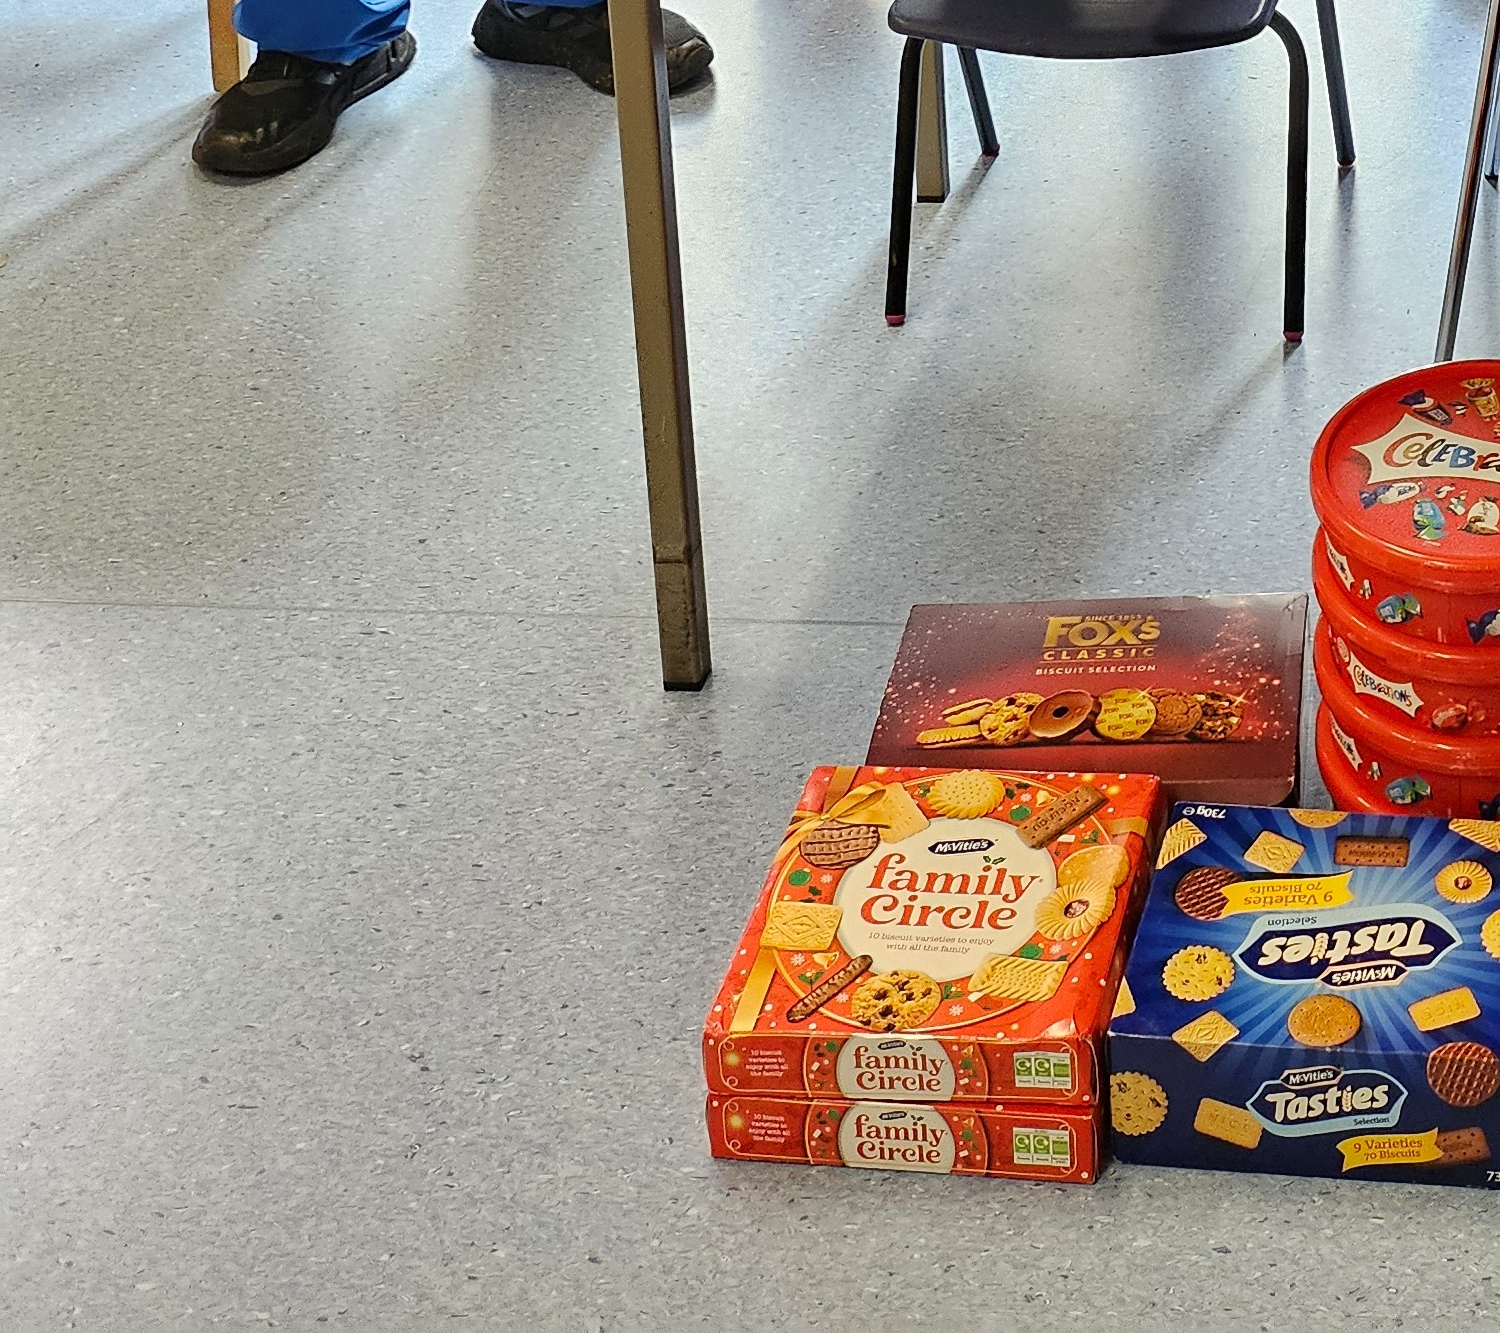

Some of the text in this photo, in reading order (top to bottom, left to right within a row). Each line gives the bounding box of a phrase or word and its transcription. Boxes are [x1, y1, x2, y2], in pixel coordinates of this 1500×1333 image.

[1043, 648, 1155, 661] CLASSIC
[1036, 664, 1156, 675] BISCUIT SELECTION
[1196, 806, 1227, 819] 730g
[866, 853, 1040, 903] family
[1249, 883, 1323, 895] 70 Biscuits
[1244, 891, 1333, 906] 9 Varieties
[860, 894, 1018, 930] Circle
[1267, 916, 1317, 926] Selection
[881, 933, 913, 941] biscuit
[915, 935, 956, 943] varieties
[1258, 919, 1435, 966] Tasties
[909, 943, 922, 951] all
[940, 945, 971, 954] family
[854, 1045, 945, 1077] family
[856, 1071, 941, 1092] Circle
[1265, 1084, 1389, 1122] Tasties
[1353, 1116, 1391, 1127] Selection
[855, 1114, 945, 1146] family
[857, 1140, 941, 1164] Circle
[1353, 1138, 1423, 1153] 9 Varieties
[1364, 1149, 1421, 1160] 70 Biscuits
